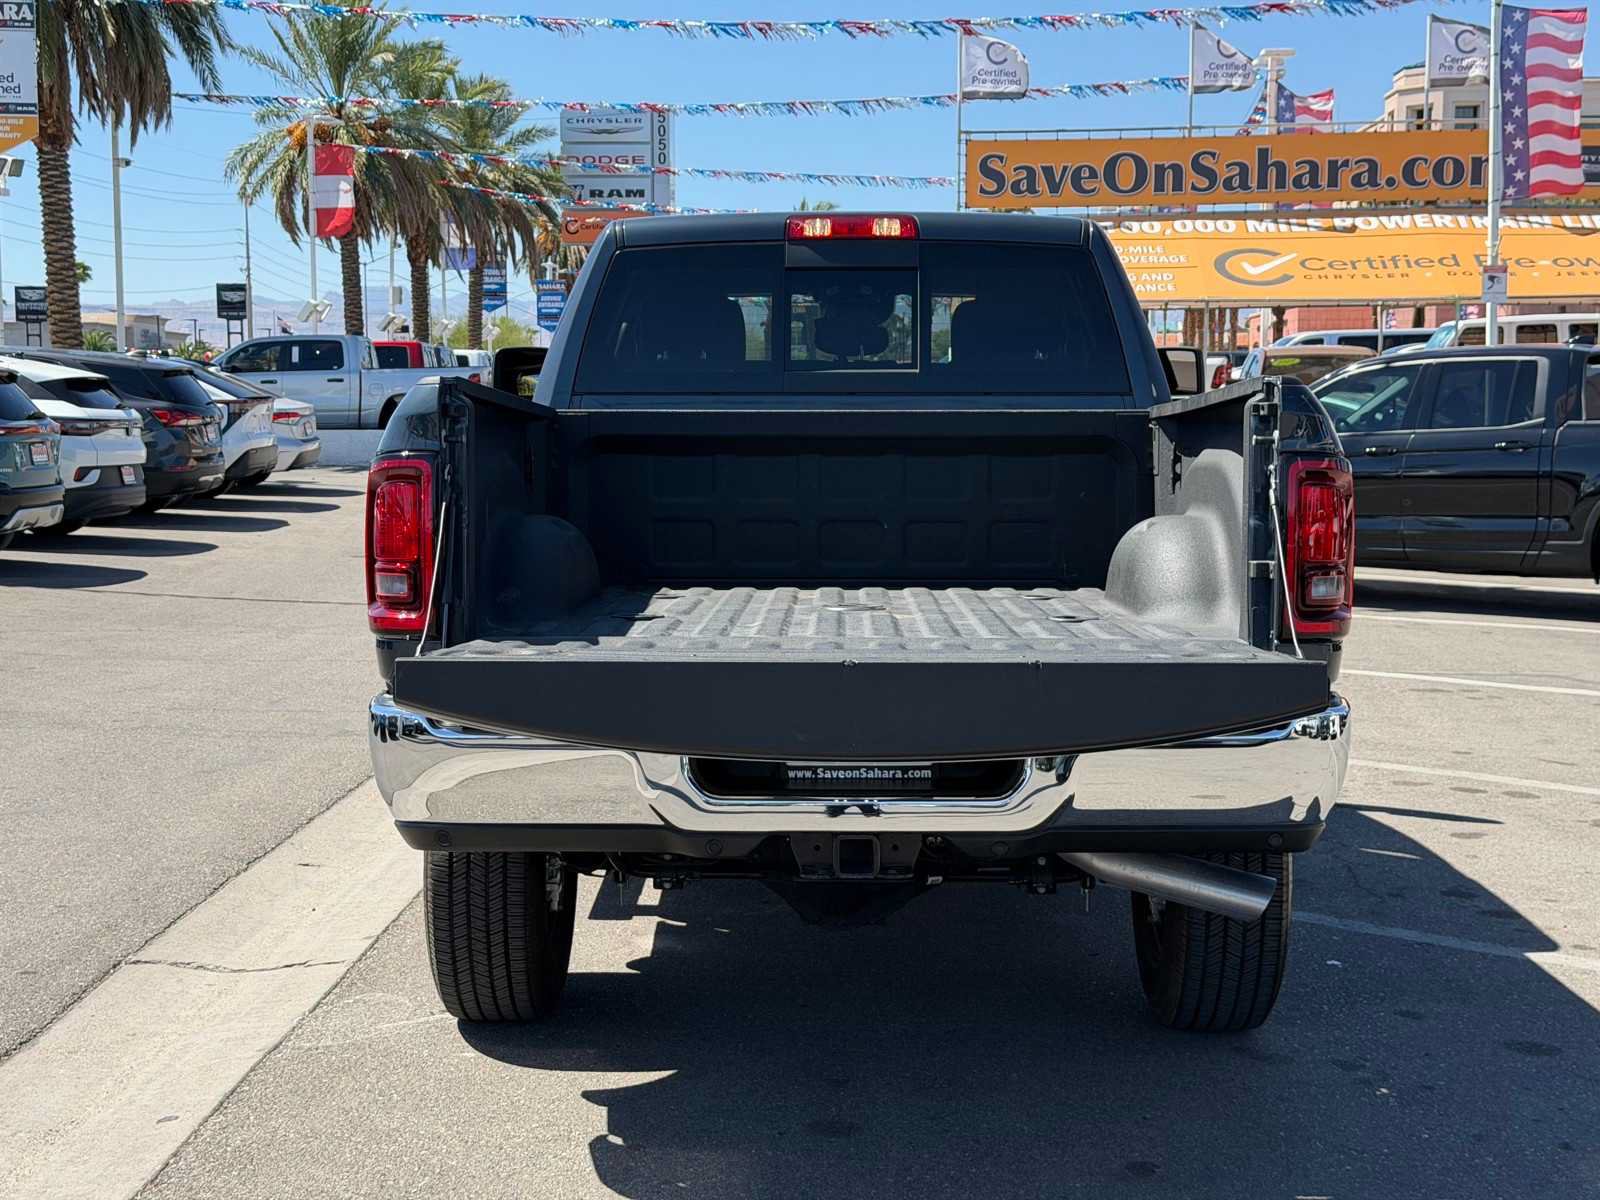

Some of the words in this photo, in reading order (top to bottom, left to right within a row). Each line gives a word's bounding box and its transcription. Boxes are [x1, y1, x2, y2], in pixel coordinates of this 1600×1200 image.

[1208, 61, 1248, 71] Certified
[977, 68, 1017, 78] Certified
[971, 75, 1022, 86] Pre-owned
[657, 111, 667, 165] 5050
[566, 155, 646, 165] DODGE
[589, 188, 646, 198] RAM
[580, 223, 604, 231] Certif
[1247, 218, 1324, 233] MILE
[1300, 254, 1460, 271] Certified
[1141, 272, 1174, 281] AND
[1135, 283, 1176, 292] ANCE
[787, 767, 933, 779] www.SaveonSahara.com
